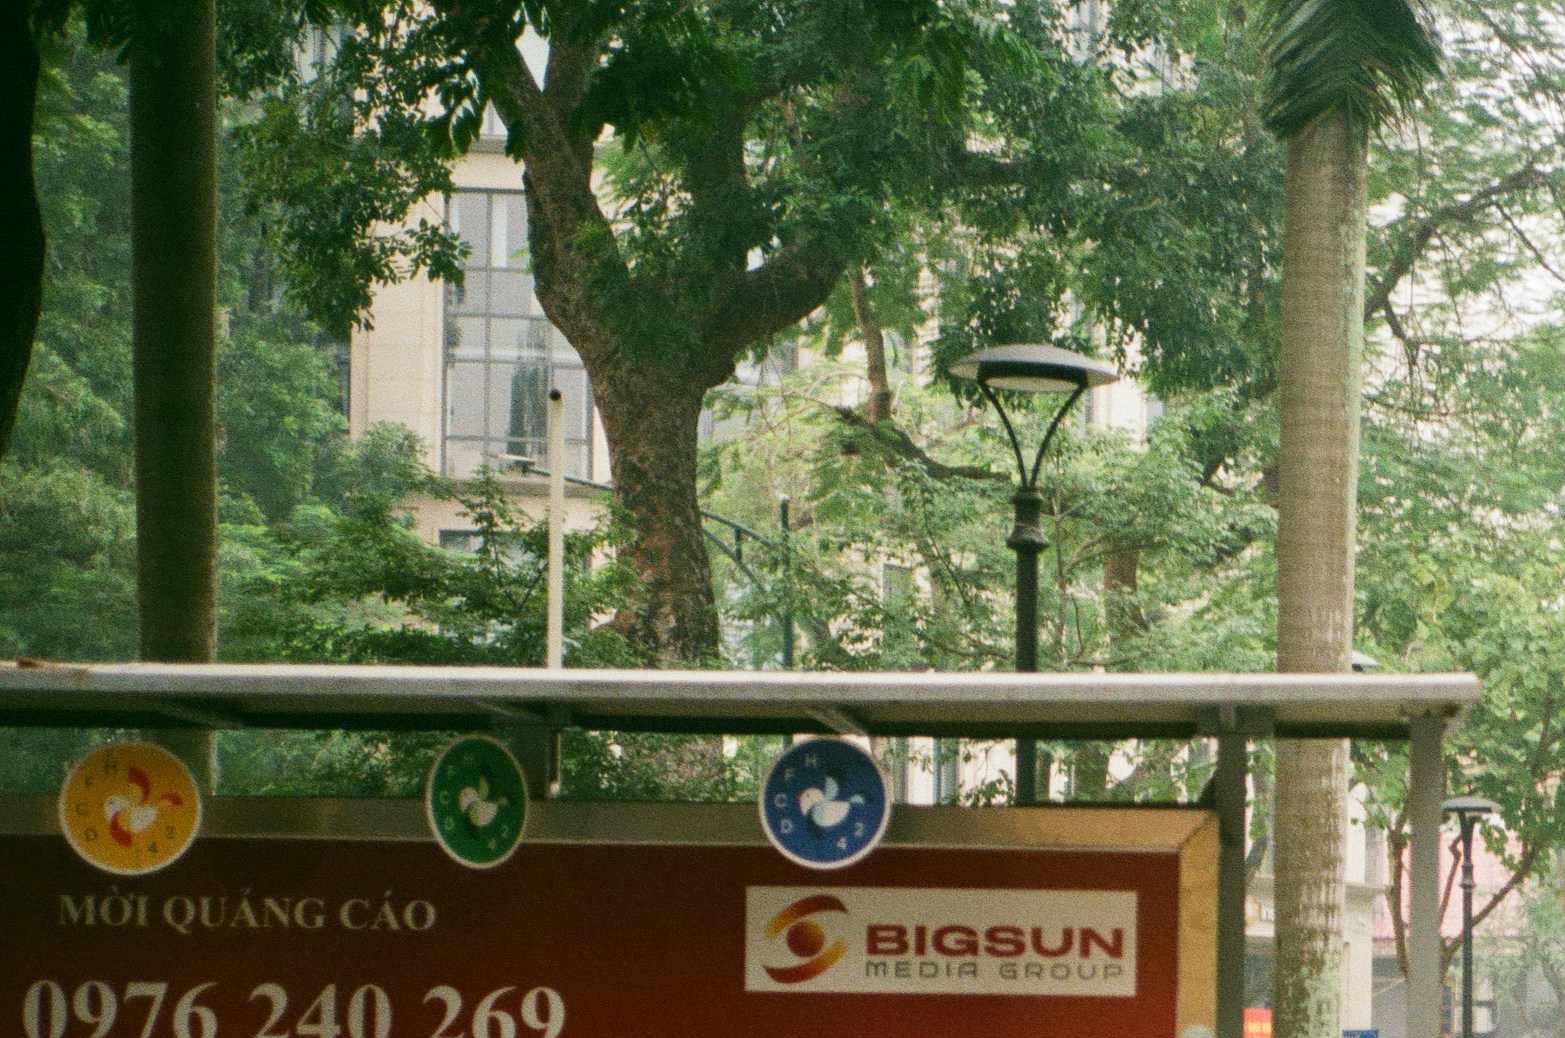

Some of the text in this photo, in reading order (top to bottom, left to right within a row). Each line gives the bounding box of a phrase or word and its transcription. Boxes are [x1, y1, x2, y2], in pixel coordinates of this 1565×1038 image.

[59, 885, 437, 934] MỜI QUẢNG CÁO
[866, 924, 1124, 959] BIGSUN
[865, 960, 1124, 981] MEDIA GROUP
